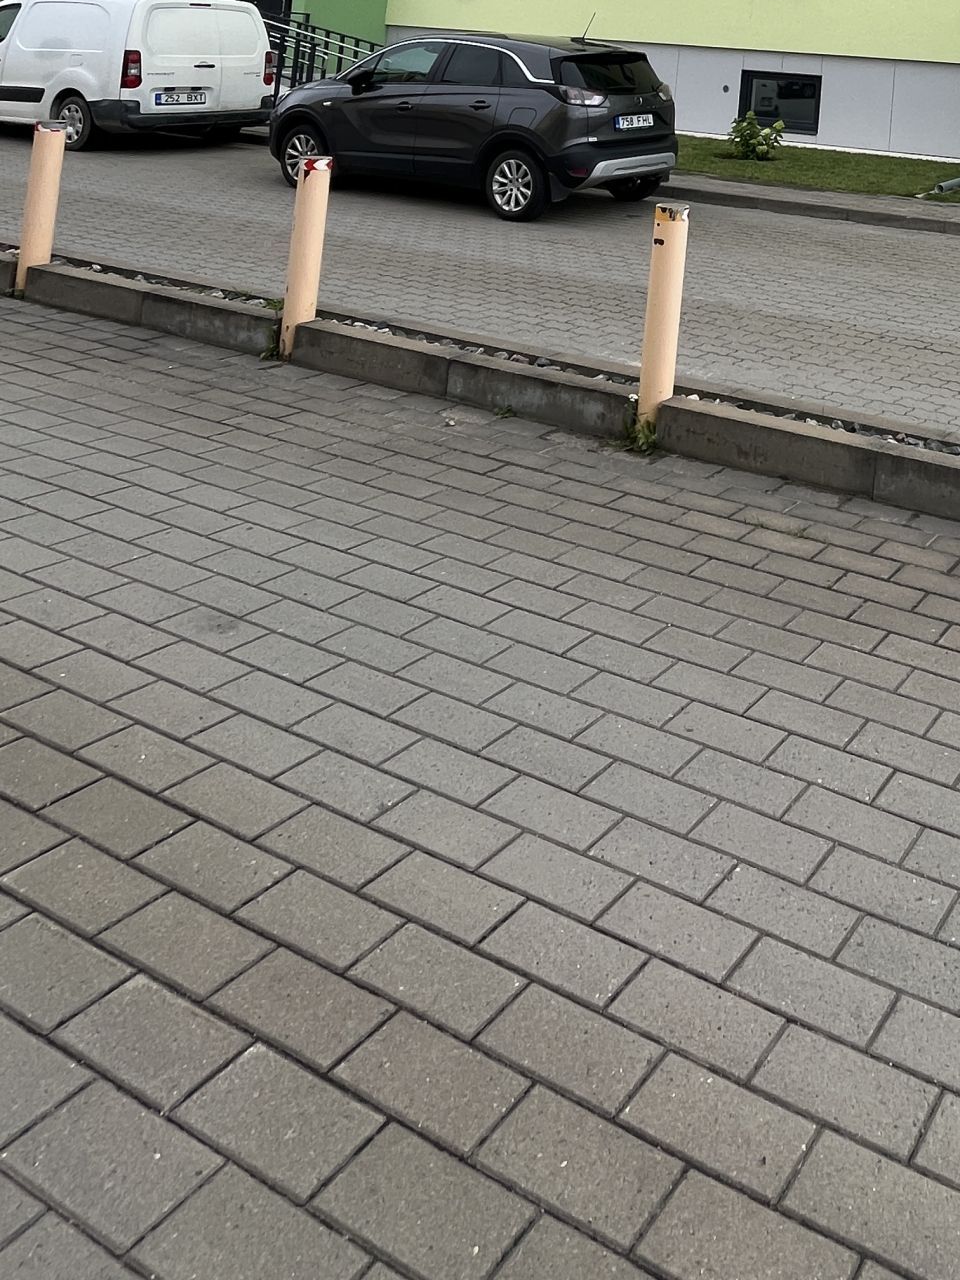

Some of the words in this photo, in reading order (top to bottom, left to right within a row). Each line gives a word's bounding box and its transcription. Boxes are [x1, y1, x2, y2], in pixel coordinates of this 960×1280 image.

[164, 94, 181, 103] 252
[186, 93, 204, 102] BXT
[621, 116, 634, 127] 758
[637, 114, 652, 126] FHL
